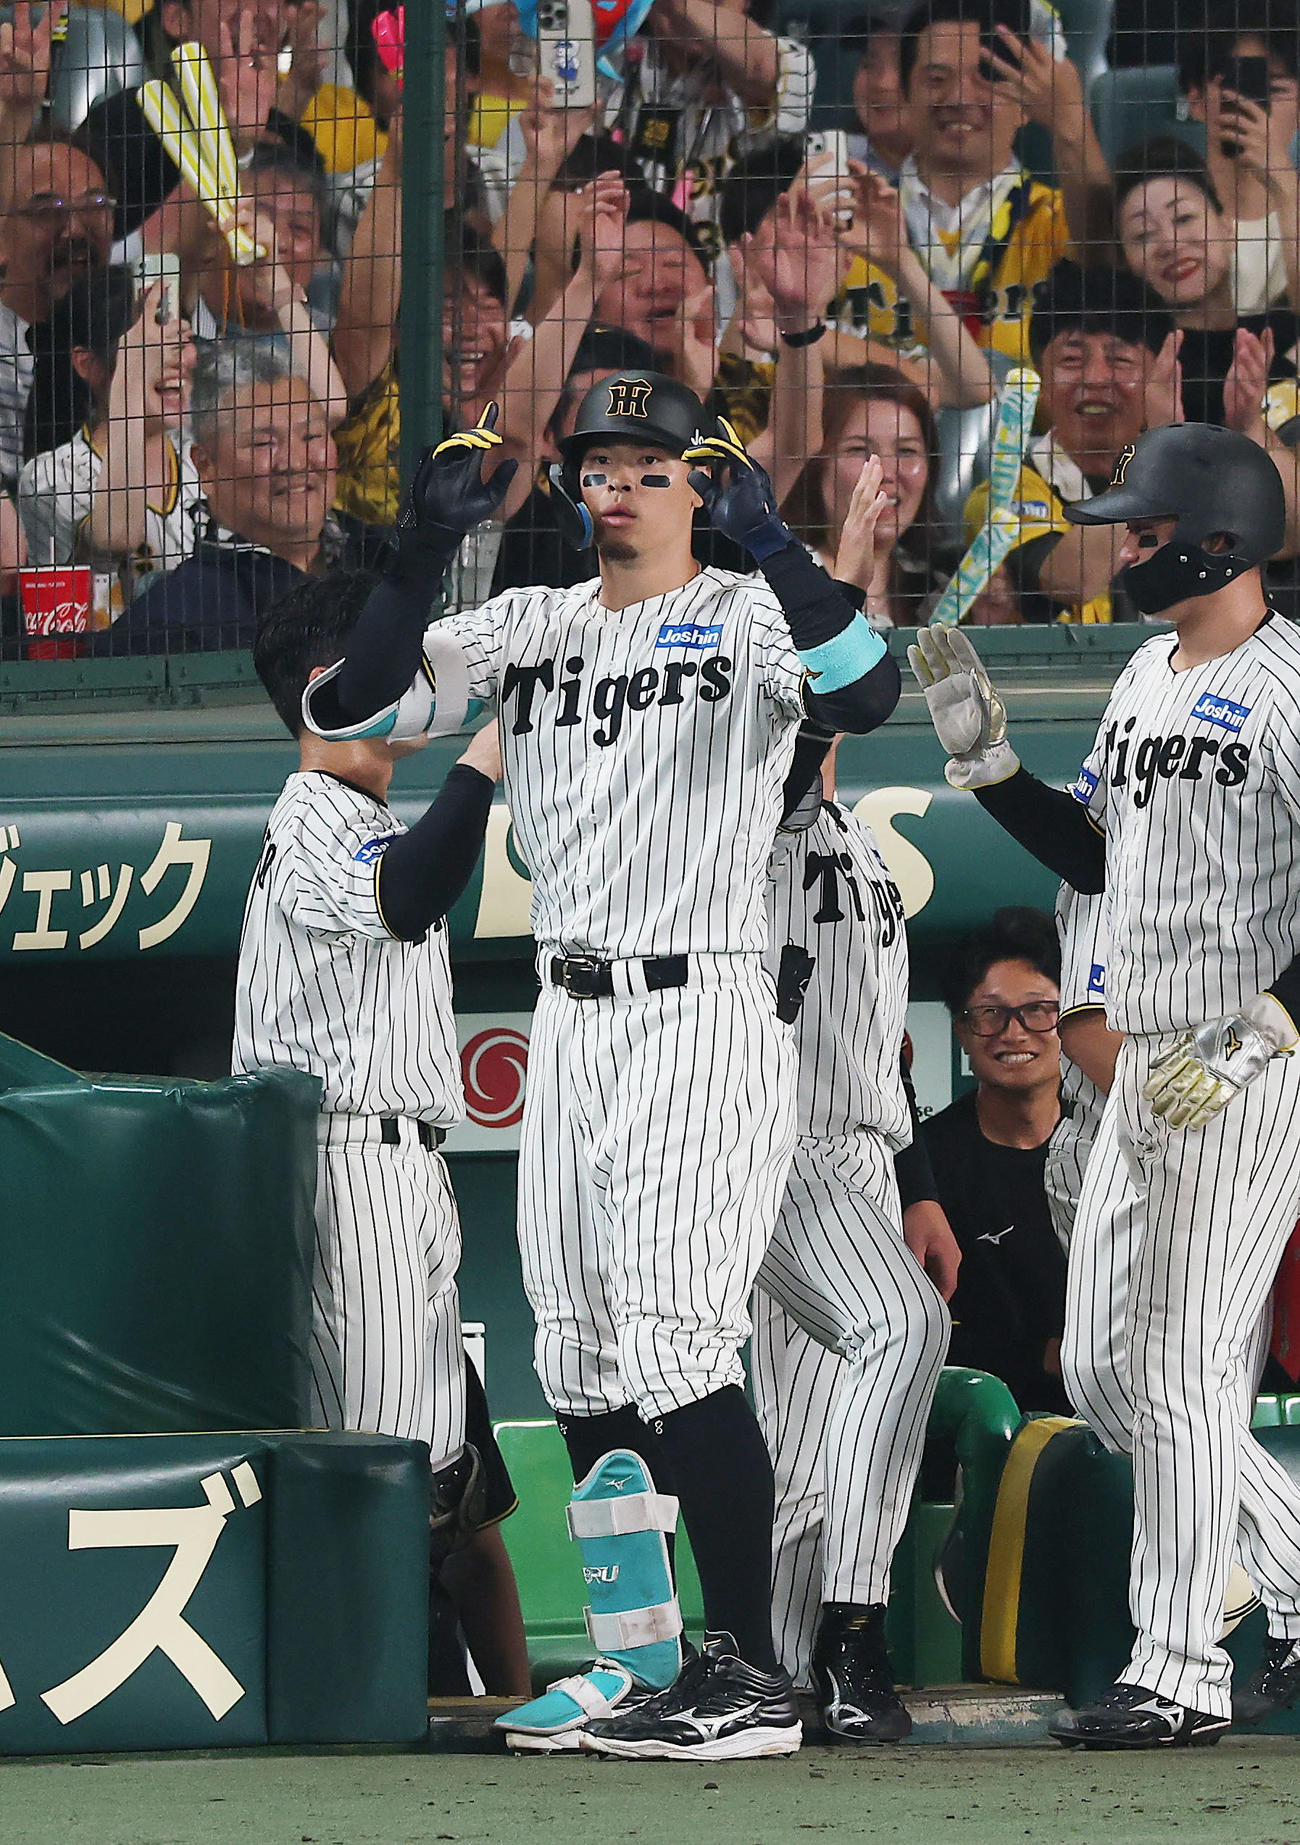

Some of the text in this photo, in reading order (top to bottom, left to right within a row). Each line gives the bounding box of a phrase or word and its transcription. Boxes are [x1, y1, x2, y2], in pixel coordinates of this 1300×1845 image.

[658, 627, 721, 646] Joshin
[502, 655, 732, 747] Tigers
[1194, 697, 1246, 728] Joshin
[0, 1460, 263, 1726] ズ
